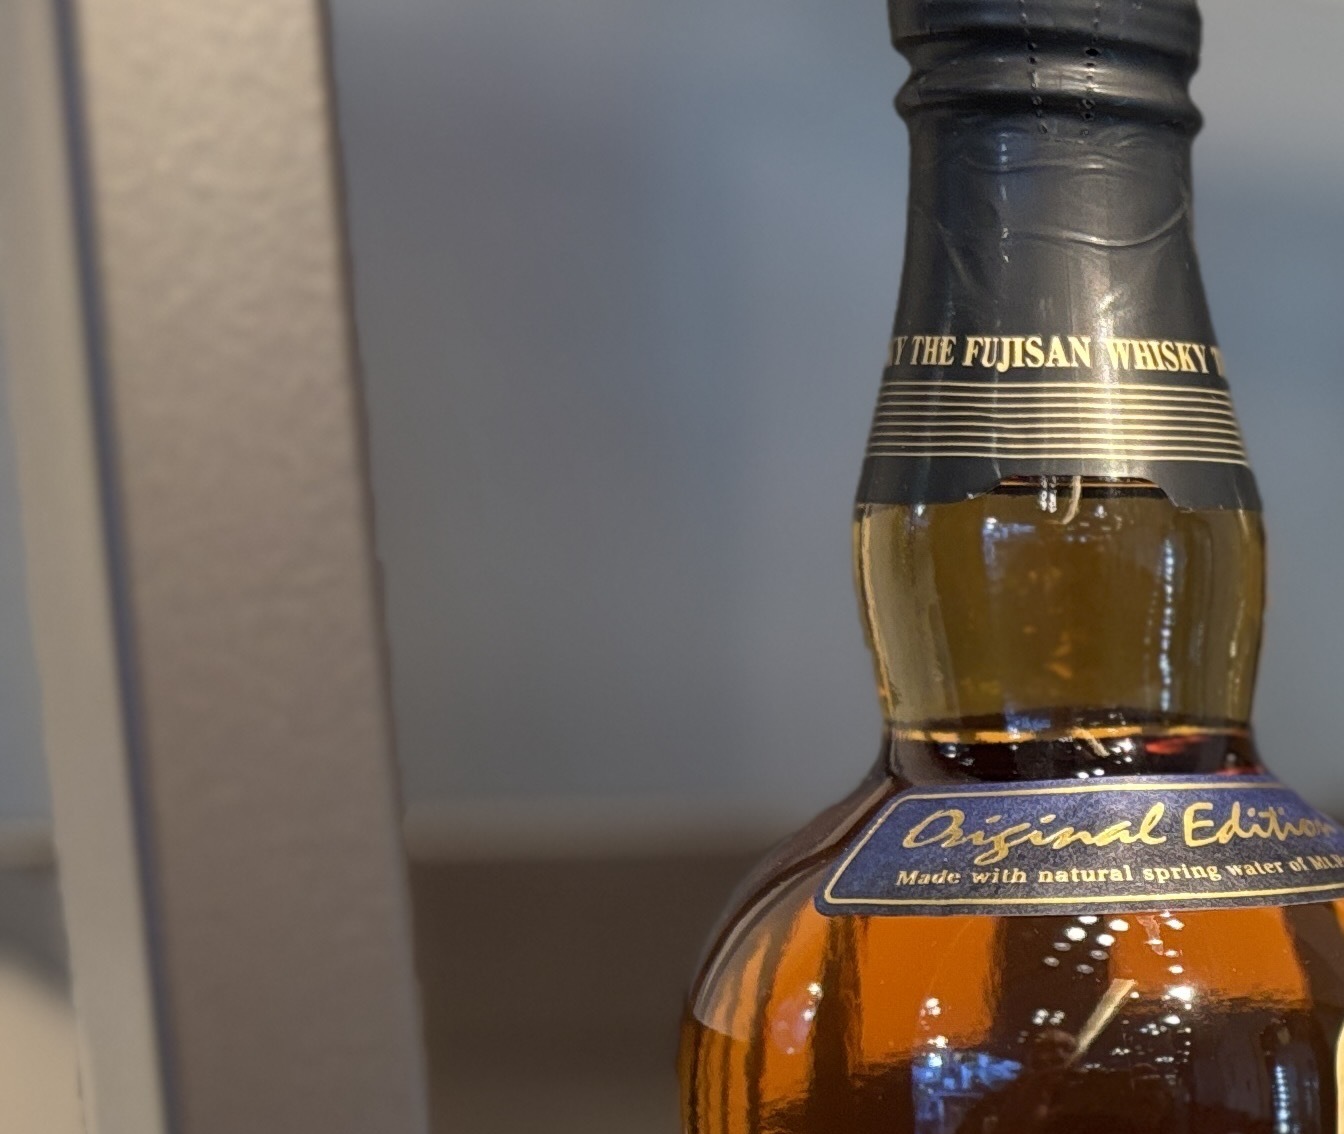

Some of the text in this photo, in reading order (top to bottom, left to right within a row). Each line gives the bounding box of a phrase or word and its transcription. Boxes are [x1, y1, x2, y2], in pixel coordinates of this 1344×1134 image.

[910, 335, 957, 366] THE
[962, 335, 1092, 373] FUJISAN
[1105, 338, 1210, 374] WHISKY
[903, 801, 1337, 867] Original Edition
[895, 869, 961, 886] Made
[972, 867, 1028, 885] with
[1038, 864, 1134, 884] natural
[1143, 863, 1222, 885] spring
[1225, 859, 1284, 876] water
[1288, 856, 1309, 872] of
